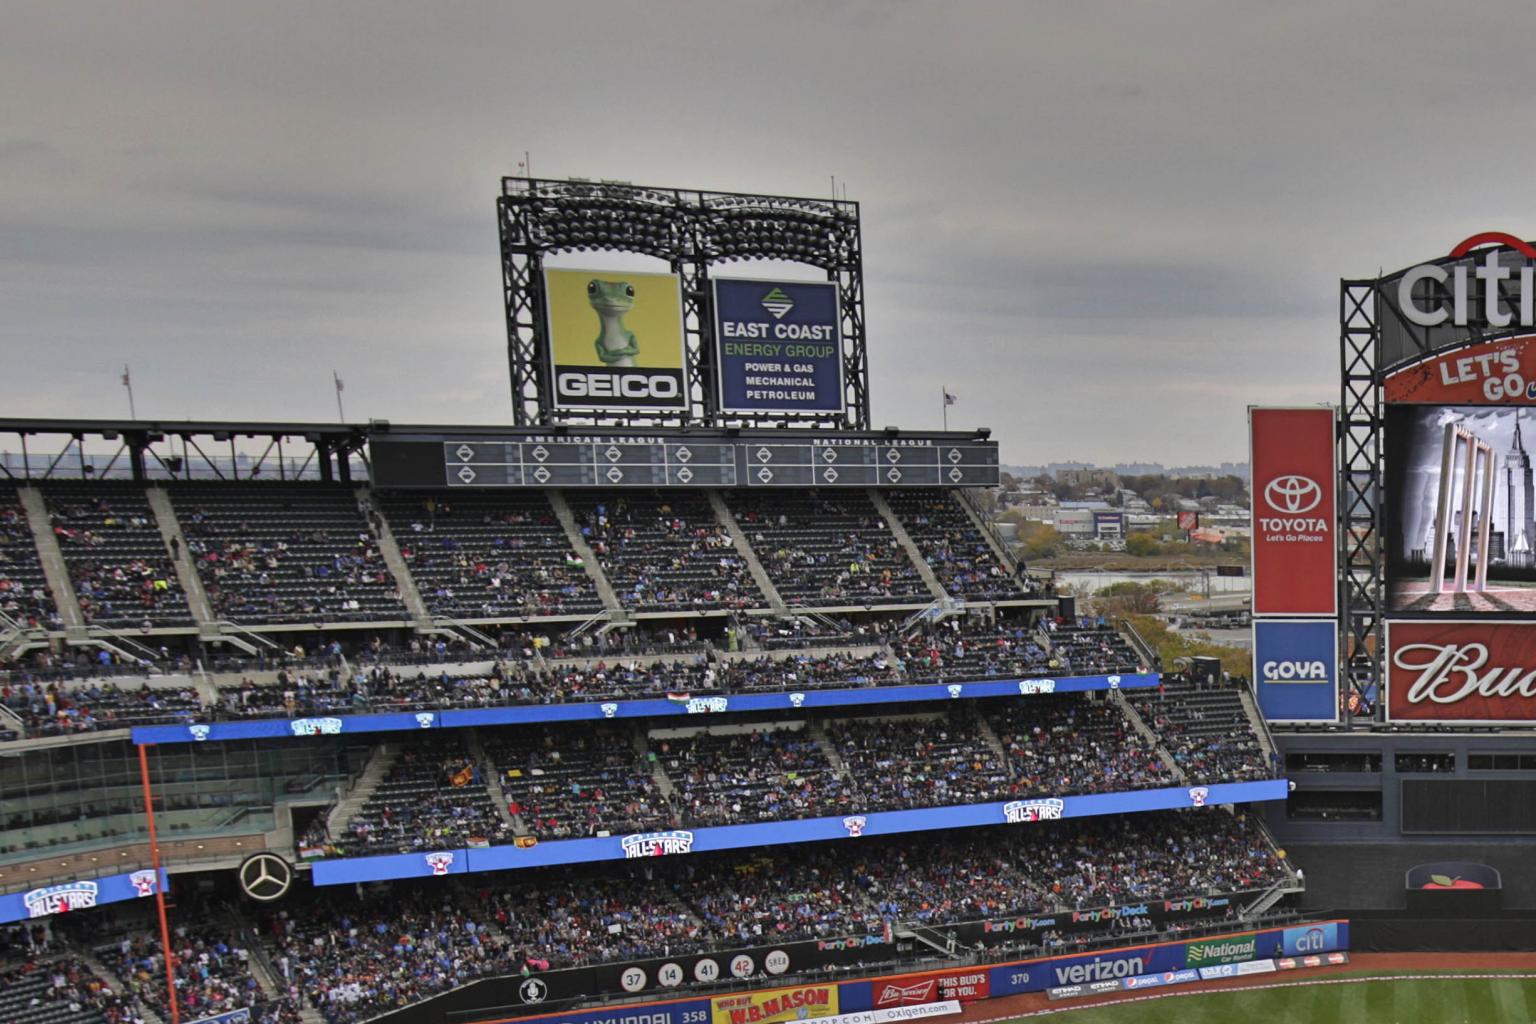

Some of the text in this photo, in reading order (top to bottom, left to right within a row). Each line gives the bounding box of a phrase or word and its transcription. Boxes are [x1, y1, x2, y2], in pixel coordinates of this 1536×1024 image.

[1399, 248, 1534, 327] citi
[723, 322, 833, 340] EAST COAST
[725, 343, 834, 359] ENERGY GROUP
[745, 363, 814, 373] POWER & GAS
[1439, 349, 1521, 386] LET'S
[558, 373, 678, 398] GEICO
[746, 376, 815, 387] MECHANICAL
[1483, 373, 1525, 400] GO
[746, 390, 815, 400] PETROLEUM
[1259, 518, 1328, 532] TOYOTA
[1266, 534, 1323, 542] Let's Go Places
[1263, 660, 1326, 680] GOYA
[1123, 904, 1147, 916] Deck
[1296, 932, 1323, 951] citi
[1203, 941, 1255, 958] National
[701, 965, 714, 977] 41
[735, 960, 750, 972] 42
[1055, 957, 1144, 985] verizon
[626, 974, 641, 986] 37
[664, 969, 677, 981] 14
[938, 974, 986, 987] THIS BUD'S
[1011, 973, 1030, 985] 370
[682, 1011, 707, 1024] 358
